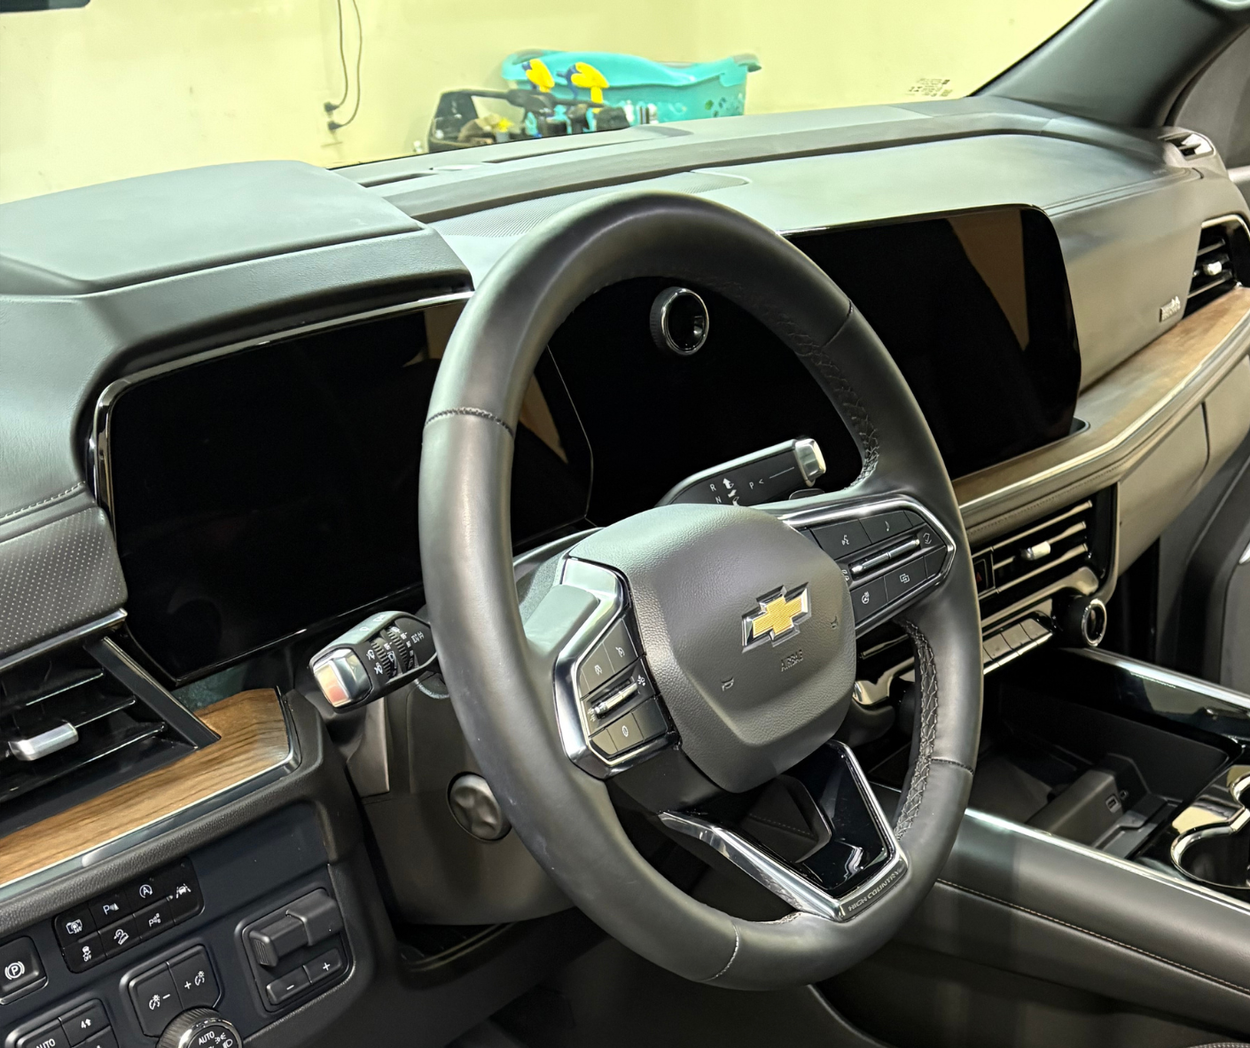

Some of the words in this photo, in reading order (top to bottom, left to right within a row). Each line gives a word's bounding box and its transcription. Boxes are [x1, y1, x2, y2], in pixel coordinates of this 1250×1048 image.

[710, 483, 717, 492] R
[715, 495, 722, 504] N
[848, 896, 868, 912] HIGH
[867, 869, 900, 899] COUNTRY
[198, 1031, 215, 1045] AUTO
